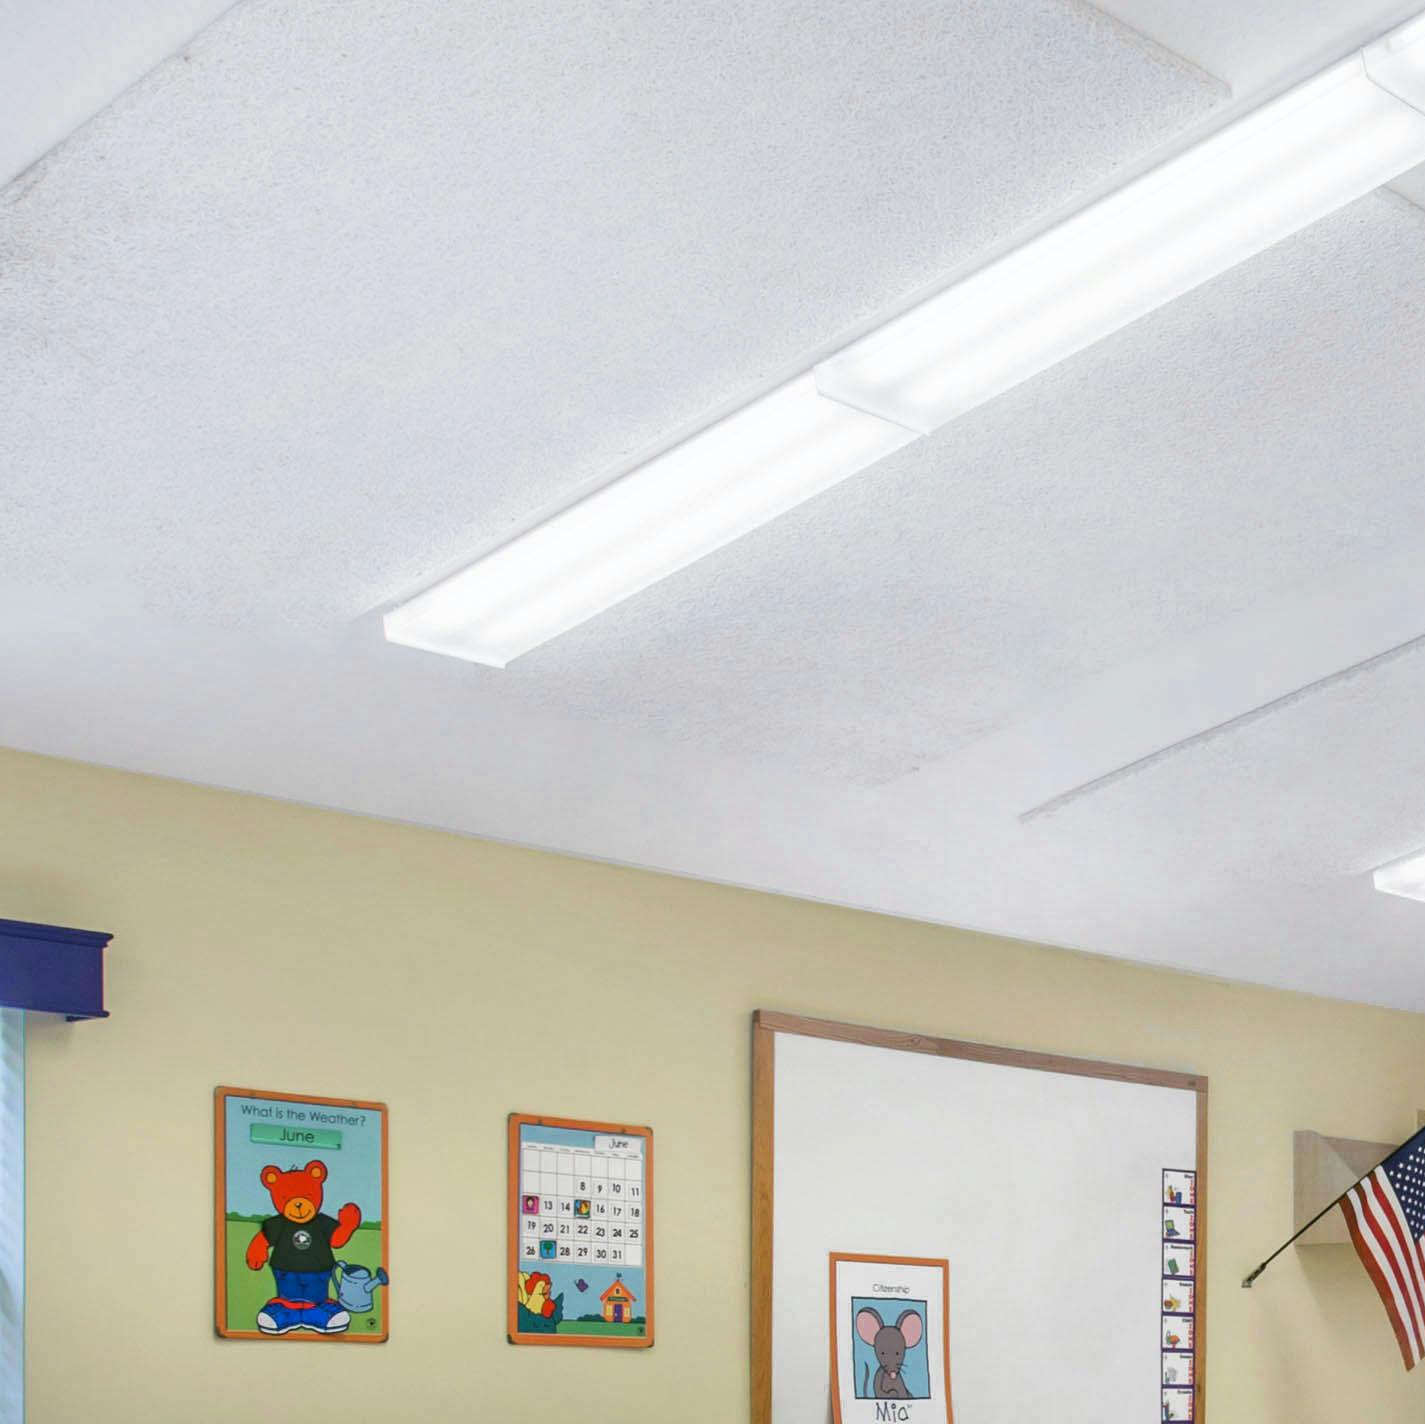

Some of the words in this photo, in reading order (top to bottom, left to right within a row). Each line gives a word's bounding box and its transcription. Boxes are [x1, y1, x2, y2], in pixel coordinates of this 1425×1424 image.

[241, 1104, 272, 1118] What
[275, 1106, 283, 1120] is
[287, 1110, 306, 1122] the
[309, 1111, 366, 1127] Weather?
[279, 1128, 315, 1144] June
[608, 1138, 629, 1149] June
[580, 1181, 586, 1191] 8
[598, 1184, 603, 1194] 9
[612, 1183, 621, 1194] 10
[631, 1187, 639, 1197] 11
[544, 1200, 553, 1210] 13
[561, 1202, 570, 1212] 14
[596, 1204, 605, 1214] 16
[613, 1207, 622, 1216] 17
[631, 1207, 640, 1217] 18
[527, 1221, 536, 1231] 19
[543, 1224, 554, 1233] 20
[560, 1225, 570, 1234] 21
[577, 1225, 588, 1234] 22
[595, 1227, 606, 1237] 23
[612, 1229, 622, 1237] 24
[629, 1229, 639, 1238] 25
[526, 1246, 536, 1255] 26
[560, 1247, 570, 1256] 28
[577, 1247, 588, 1257] 29
[595, 1249, 606, 1259] 30
[612, 1250, 622, 1259] 31
[875, 1401, 910, 1423] Mia
